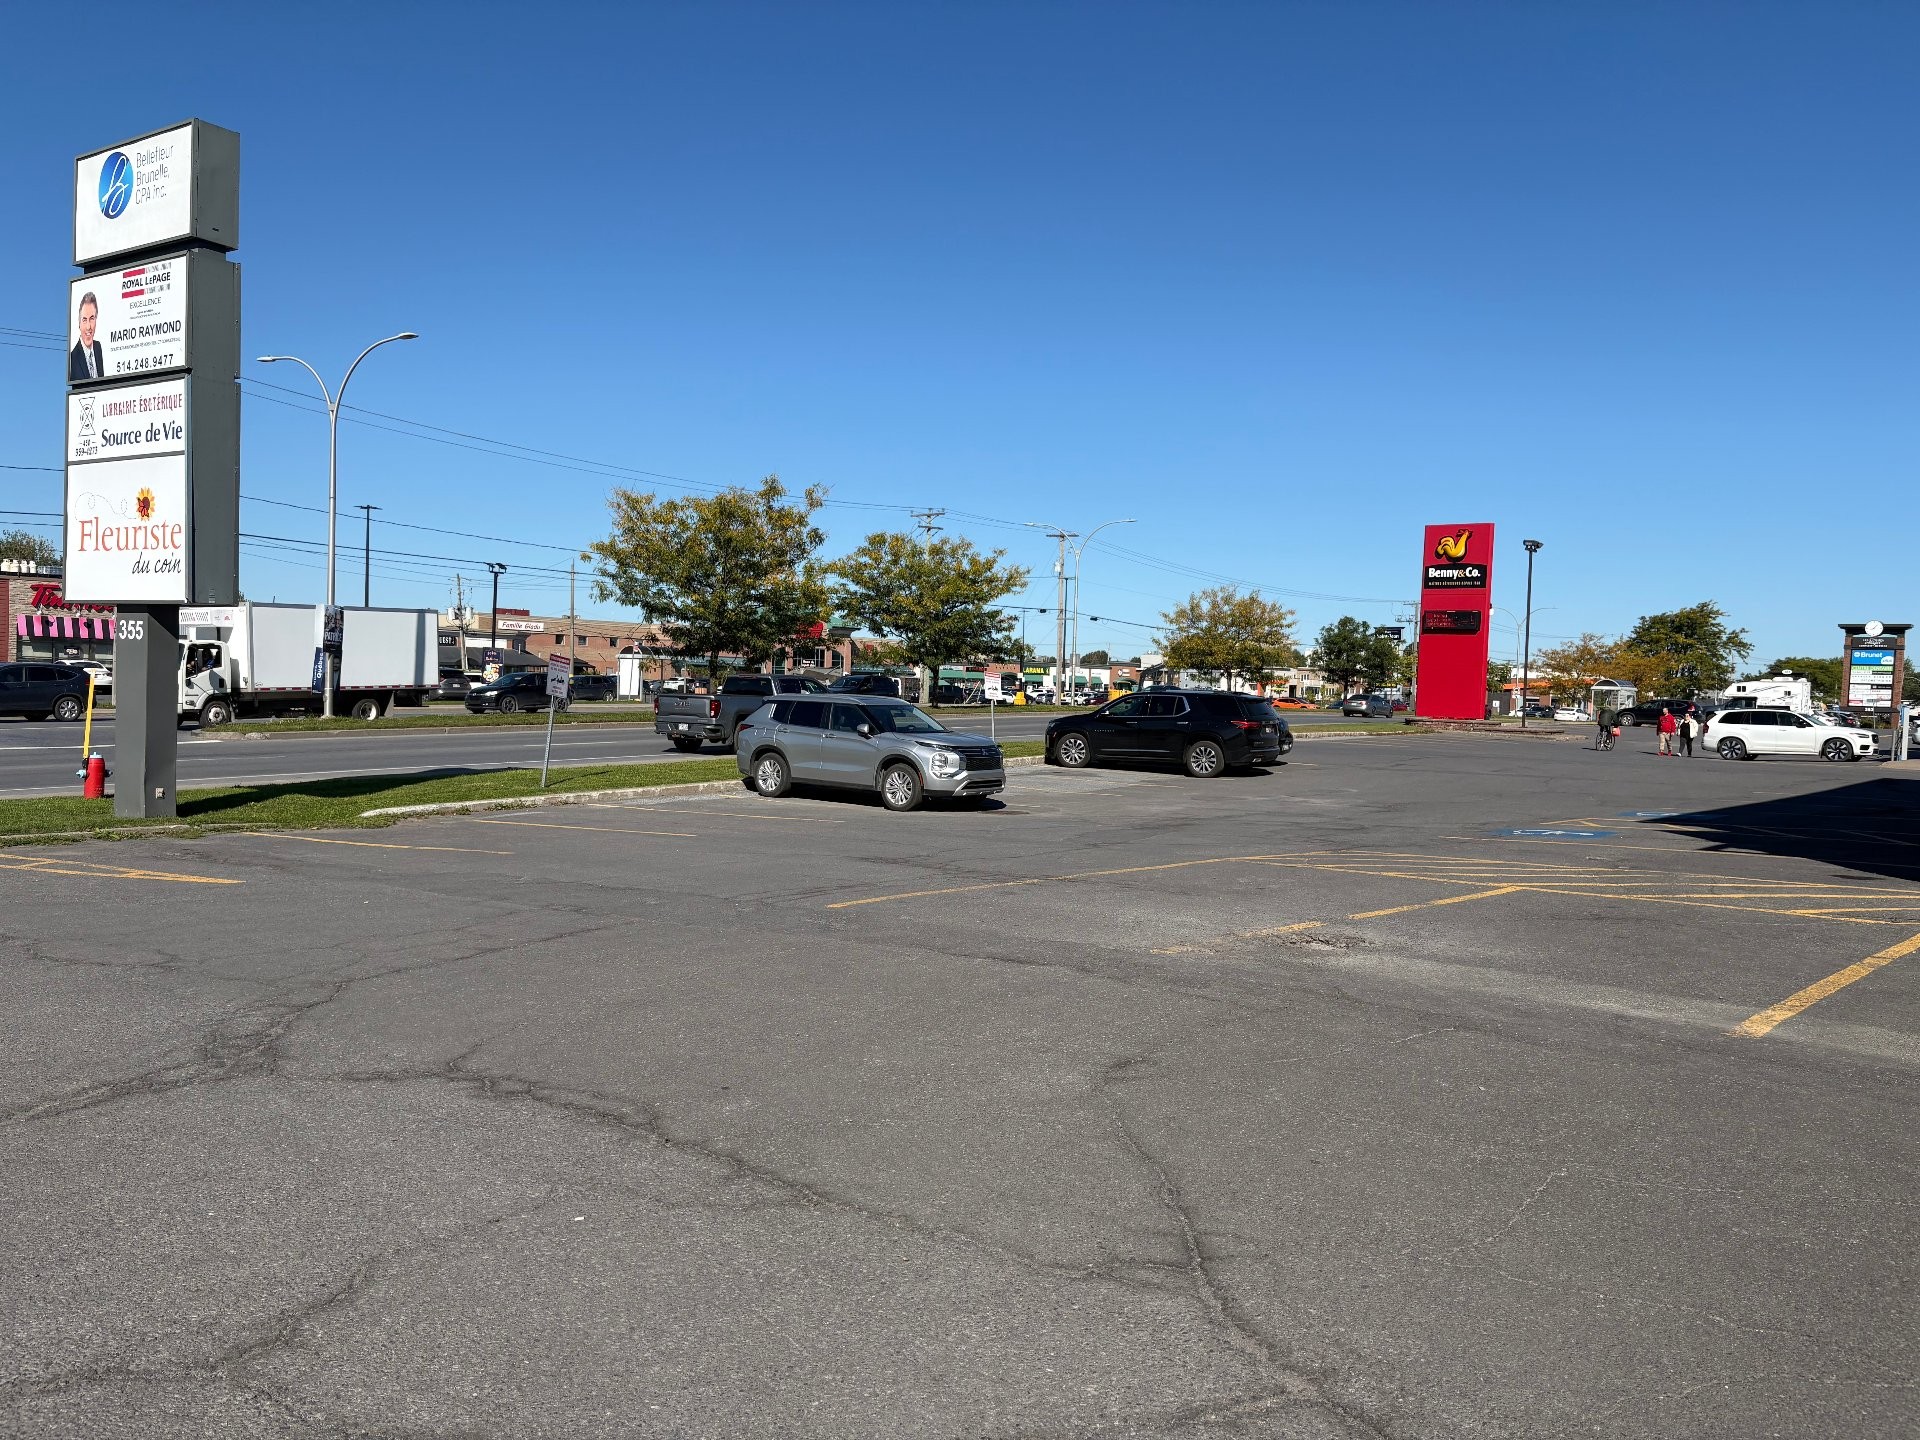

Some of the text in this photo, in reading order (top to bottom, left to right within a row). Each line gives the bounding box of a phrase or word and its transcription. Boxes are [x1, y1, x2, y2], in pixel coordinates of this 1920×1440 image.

[136, 145, 174, 168] Bellefleur
[136, 163, 170, 187] Brunelle,
[135, 186, 151, 205] CPA
[121, 277, 144, 291] ROYAL
[110, 319, 182, 343] MARIO RAYMOND
[116, 353, 174, 373] 514.248.9477
[102, 393, 183, 418] LIBRAIRIE ÉSOTÉRIQUE
[101, 419, 183, 448] Source de Vie
[77, 516, 182, 552] Fleuriste
[131, 552, 182, 574] du coin
[118, 619, 144, 641] 355
